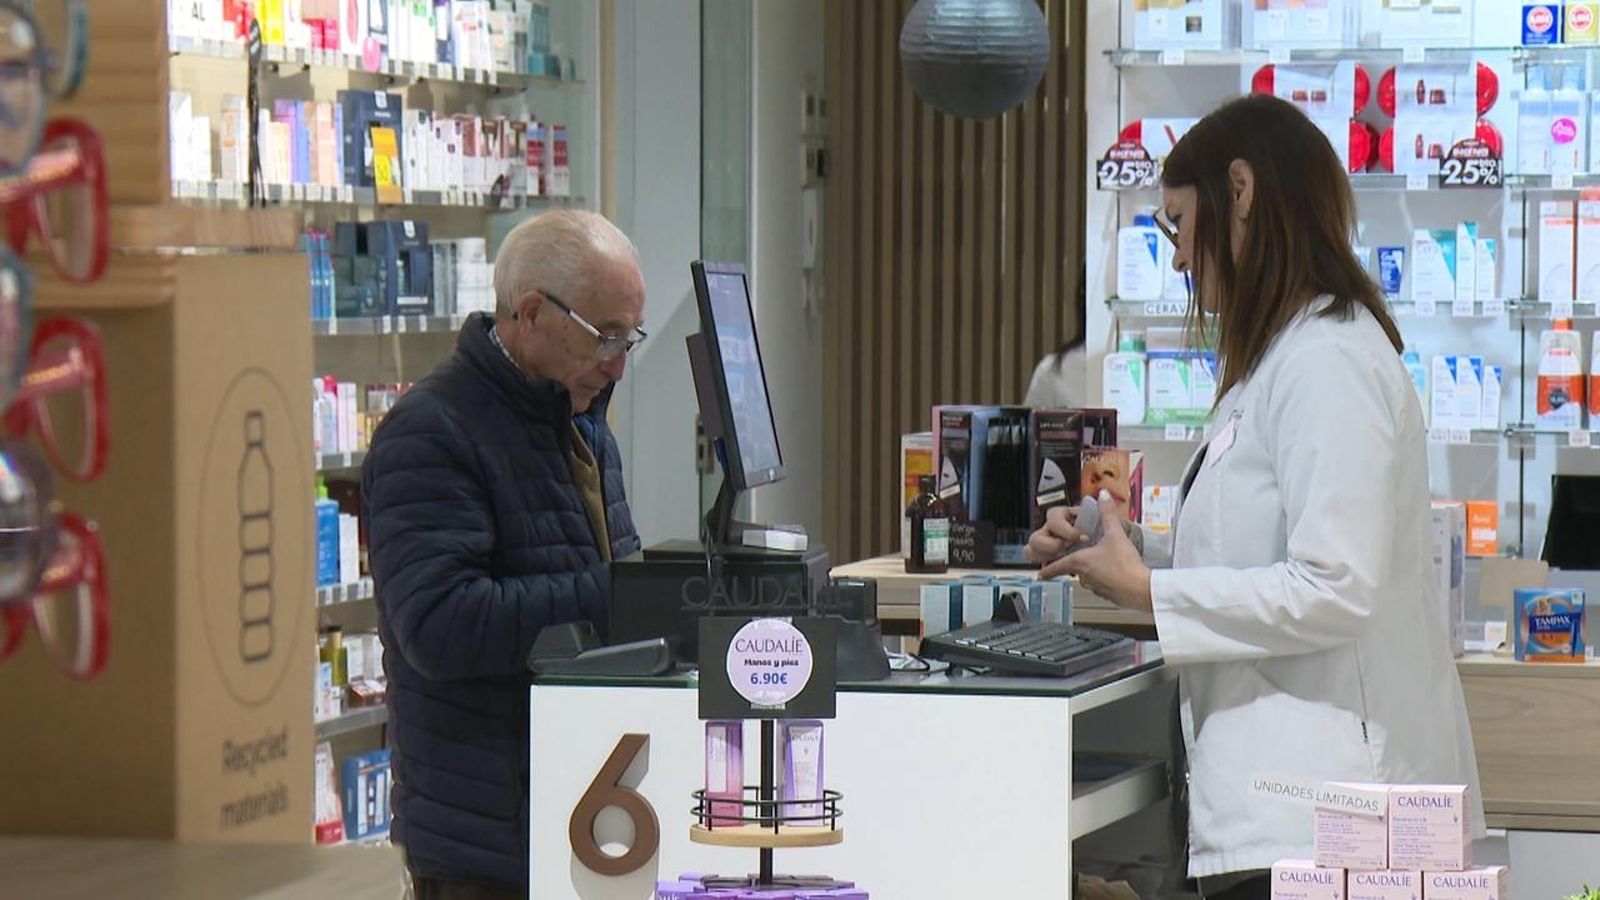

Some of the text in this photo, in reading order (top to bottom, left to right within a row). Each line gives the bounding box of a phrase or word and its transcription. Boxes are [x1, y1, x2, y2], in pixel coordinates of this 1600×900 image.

[1440, 158, 1498, 185] -25%
[1145, 304, 1186, 314] CERAV
[1535, 615, 1571, 627] TAMPAX
[735, 636, 803, 653] CAUDALÍE
[774, 660, 780, 668] y
[750, 673, 788, 685] 6.90€
[221, 724, 288, 778] Recycled
[1254, 779, 1380, 812] UNIDADES LIMITADAS
[1397, 795, 1454, 808] CAUDALÍE
[219, 780, 288, 828] materials
[569, 733, 660, 876] 6
[1279, 871, 1335, 885] CAUDALÍE
[1356, 875, 1412, 887] CAUDALÍE
[1433, 877, 1490, 889] CAUDALÍE
